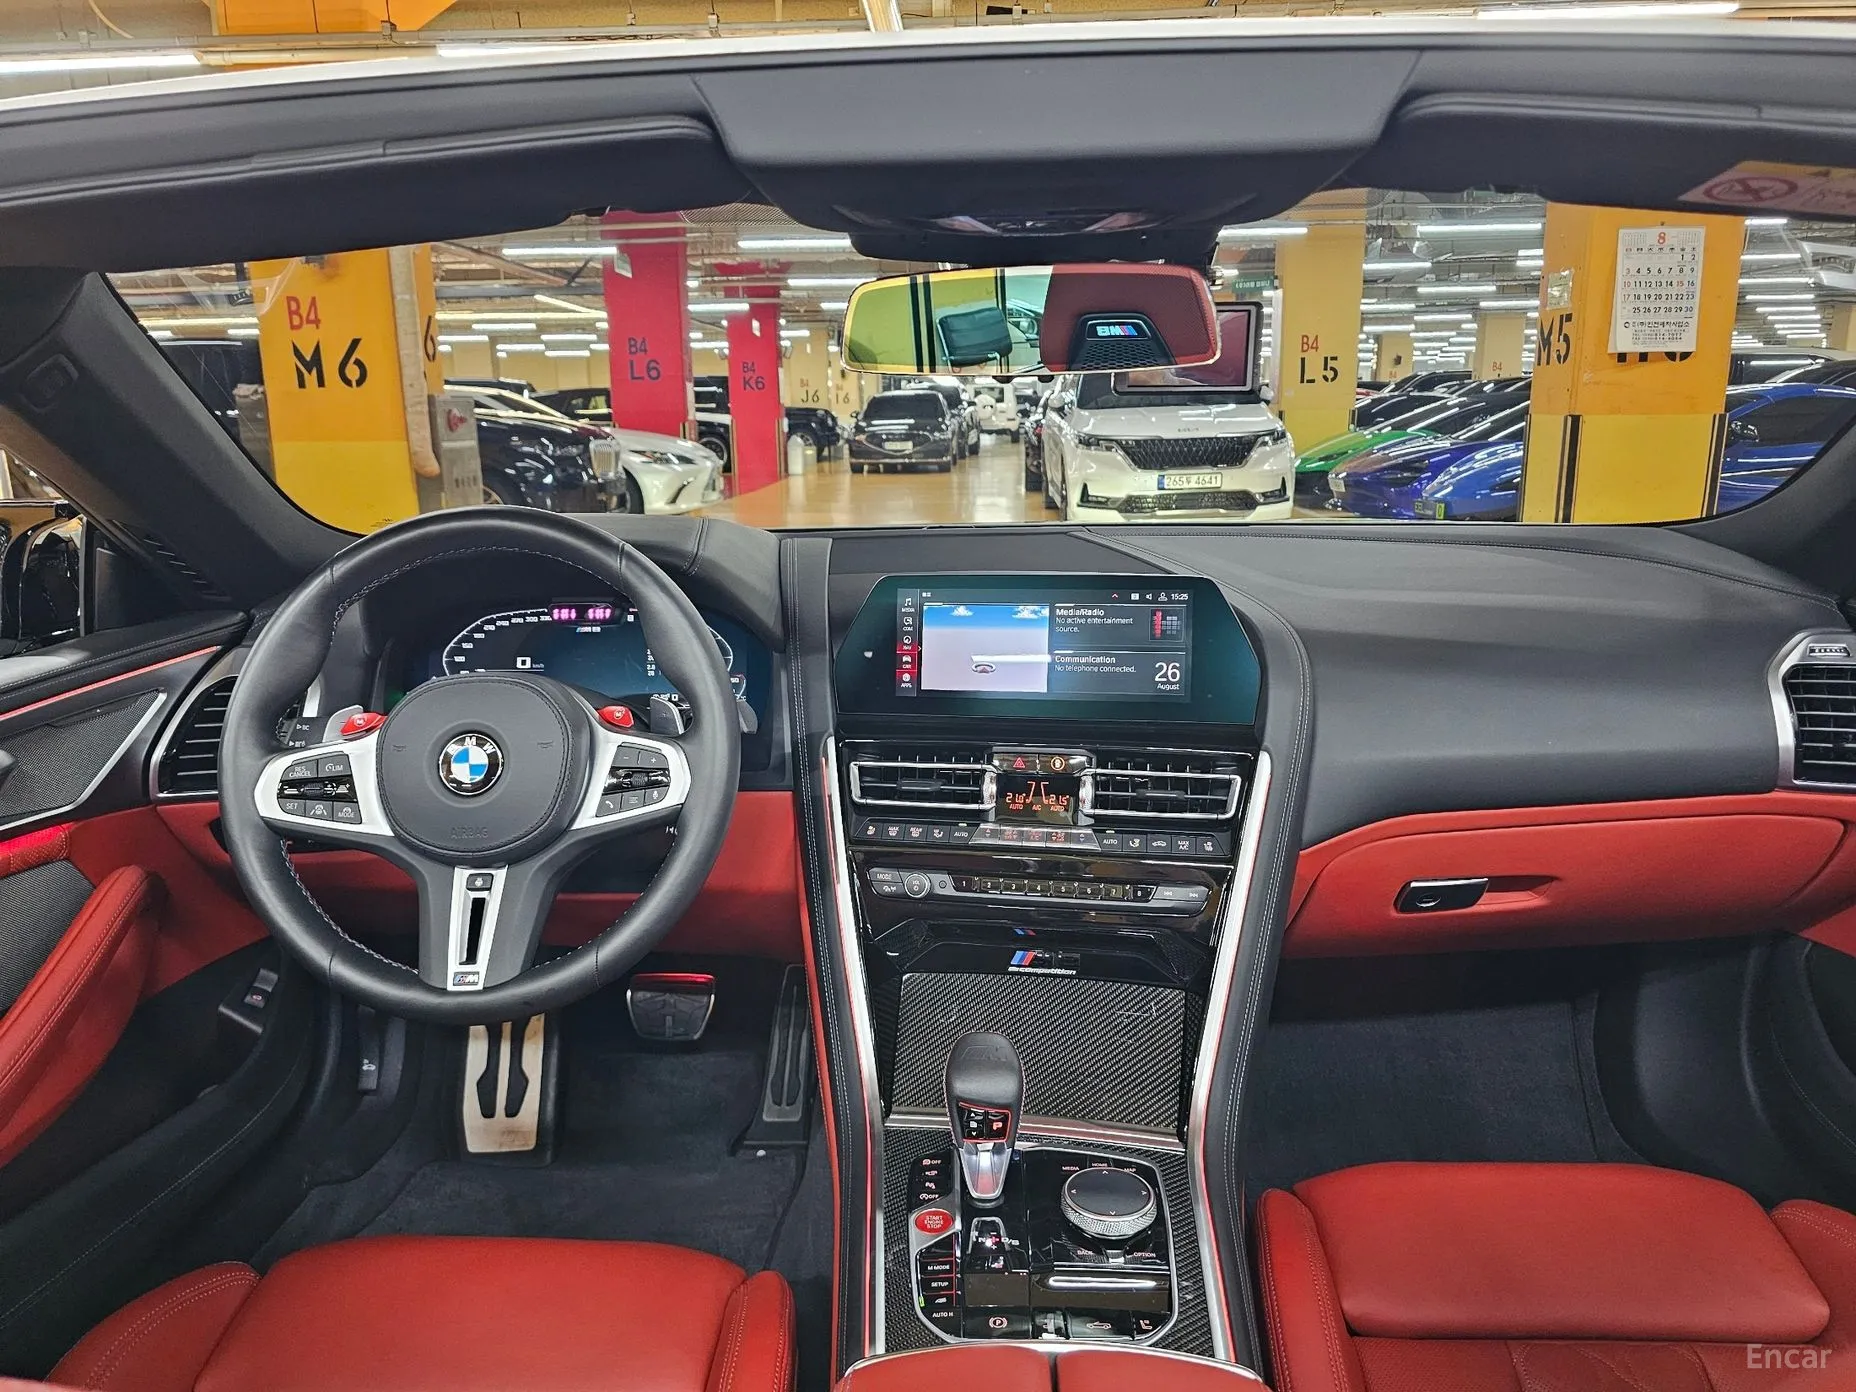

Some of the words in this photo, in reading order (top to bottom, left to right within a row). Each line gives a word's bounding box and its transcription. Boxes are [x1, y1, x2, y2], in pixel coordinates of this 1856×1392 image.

[1657, 231, 1666, 244] 8
[286, 296, 321, 330] B4
[424, 315, 436, 362] 6
[1301, 334, 1319, 352] B4
[1537, 313, 1573, 366] M5
[627, 337, 648, 355] B4
[629, 359, 661, 381] L6
[742, 361, 755, 374] B4
[1299, 356, 1339, 384] L5
[1492, 362, 1502, 372] B4
[743, 376, 765, 391] K6
[801, 389, 820, 403] J6
[1195, 475, 1218, 486] 4641
[1056, 608, 1105, 616] Media/Radio
[1055, 625, 1080, 633] source.
[516, 656, 531, 669] 0
[1055, 655, 1116, 664] Communication
[1065, 665, 1099, 674] telephone
[1154, 662, 1181, 682] 26
[1157, 683, 1180, 691] August
[446, 737, 496, 755] BMW
[992, 1122, 1002, 1130] P
